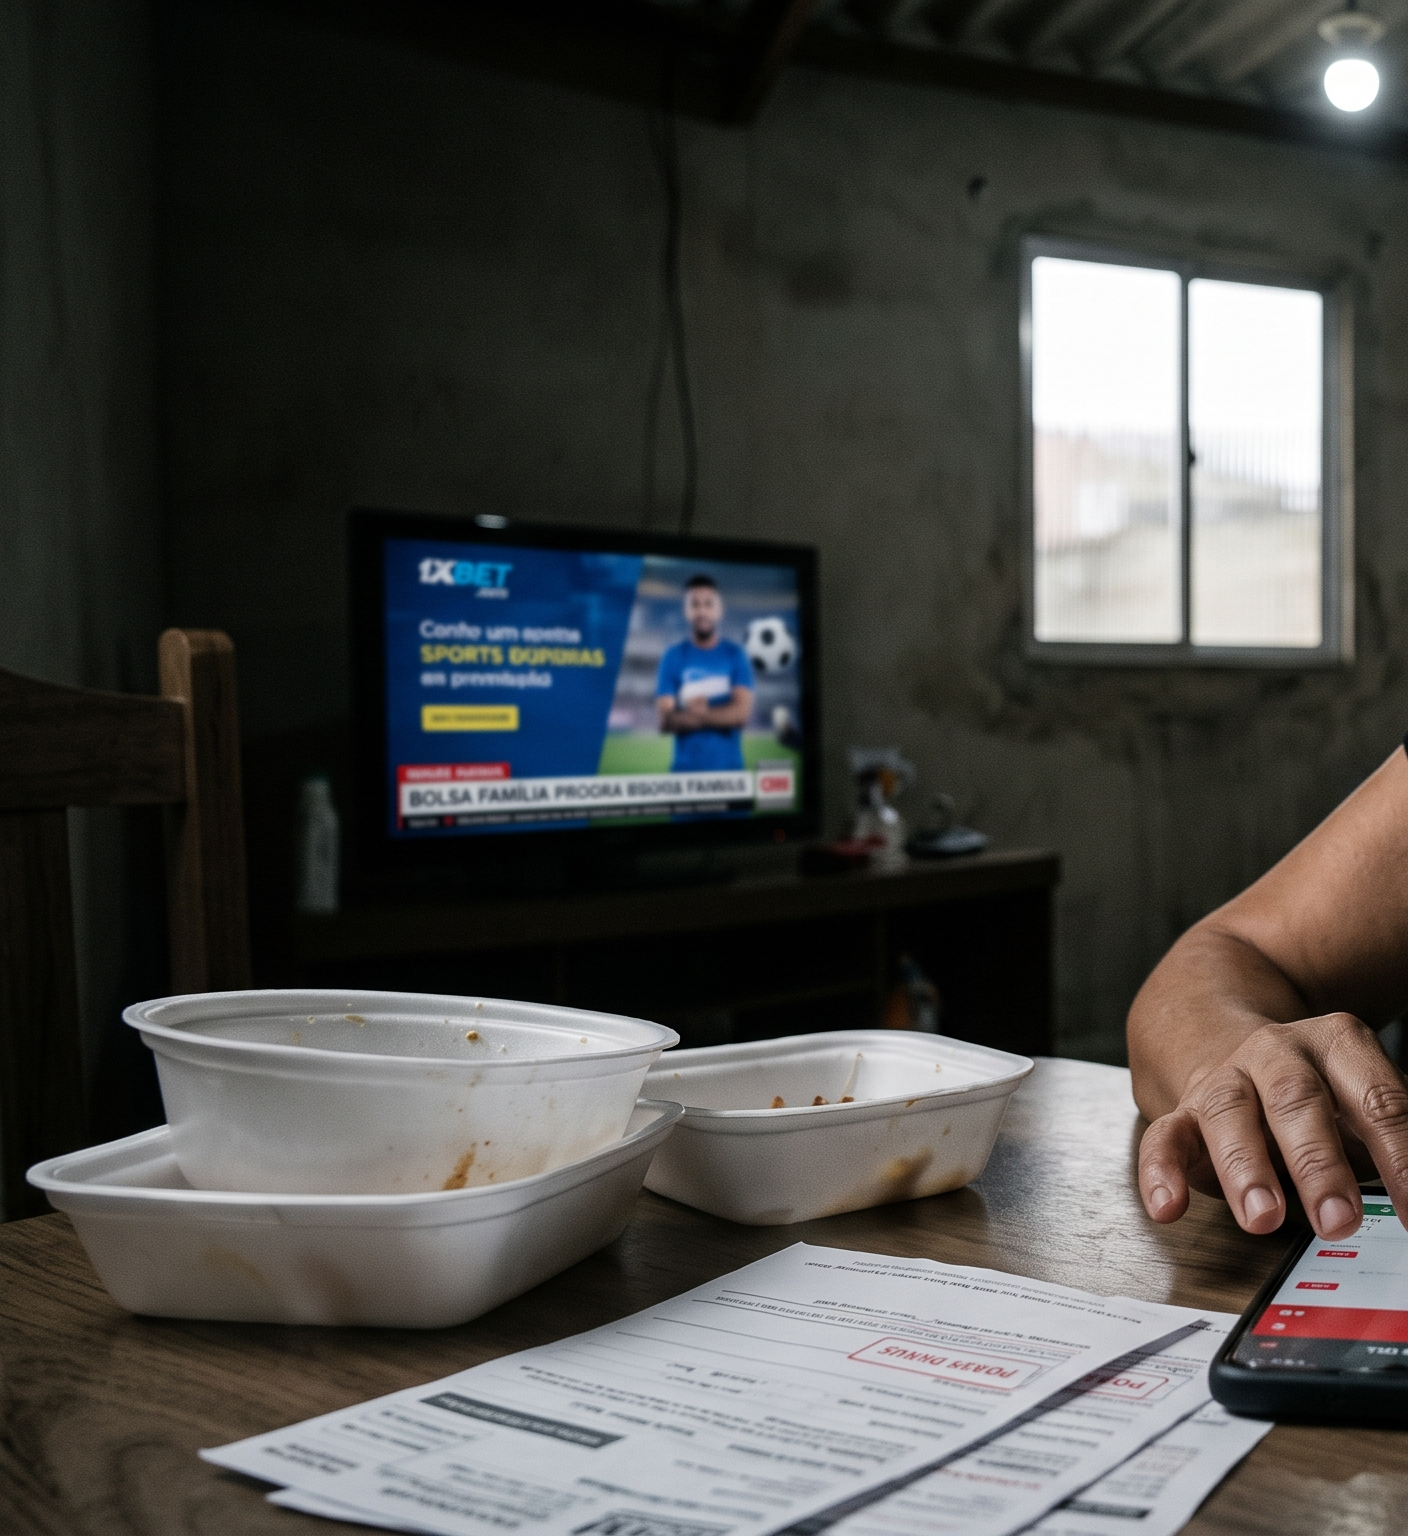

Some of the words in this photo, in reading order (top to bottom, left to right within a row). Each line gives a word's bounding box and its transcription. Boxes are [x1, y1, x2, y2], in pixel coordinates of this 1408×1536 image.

[420, 644, 503, 665] SPORTS
[409, 788, 472, 808] BOLSA
[478, 784, 549, 803] FAMÍLIA
